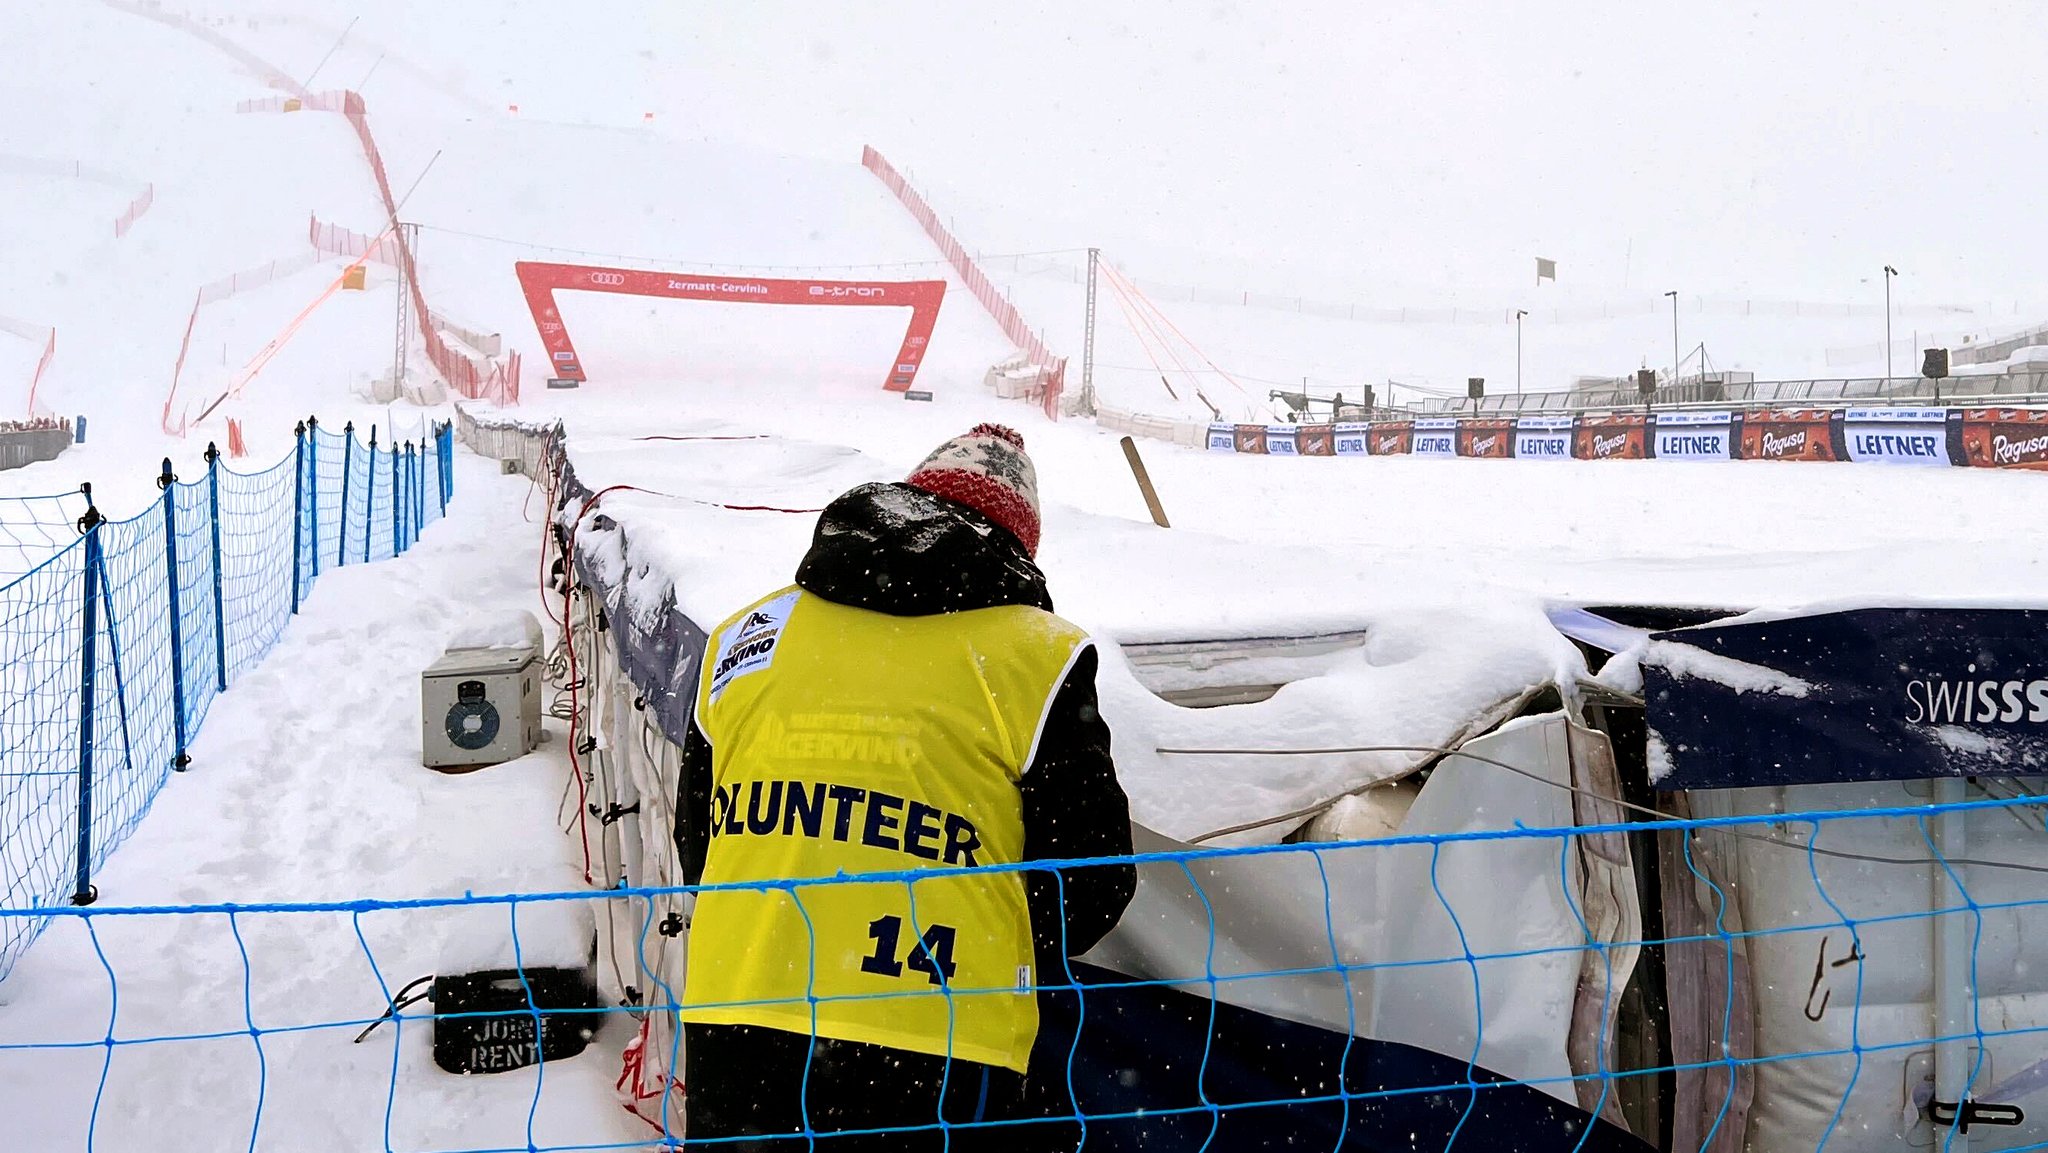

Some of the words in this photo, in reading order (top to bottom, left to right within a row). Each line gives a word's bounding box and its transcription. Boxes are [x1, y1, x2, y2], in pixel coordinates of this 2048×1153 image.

[668, 280, 768, 295] Zermatt-Cervinia
[1338, 440, 1363, 452] LEITNER
[1416, 438, 1451, 452] LEITNER
[1521, 439, 1565, 455] LEITNER
[1593, 433, 1626, 456] Ragusa
[1663, 436, 1721, 454] LEITNER
[1762, 431, 1805, 456] Ragusa
[1855, 435, 1938, 457] LEITNER
[1993, 435, 2048, 463] Ragusa
[710, 780, 982, 867] OLUNTEER
[860, 914, 957, 986] 14
